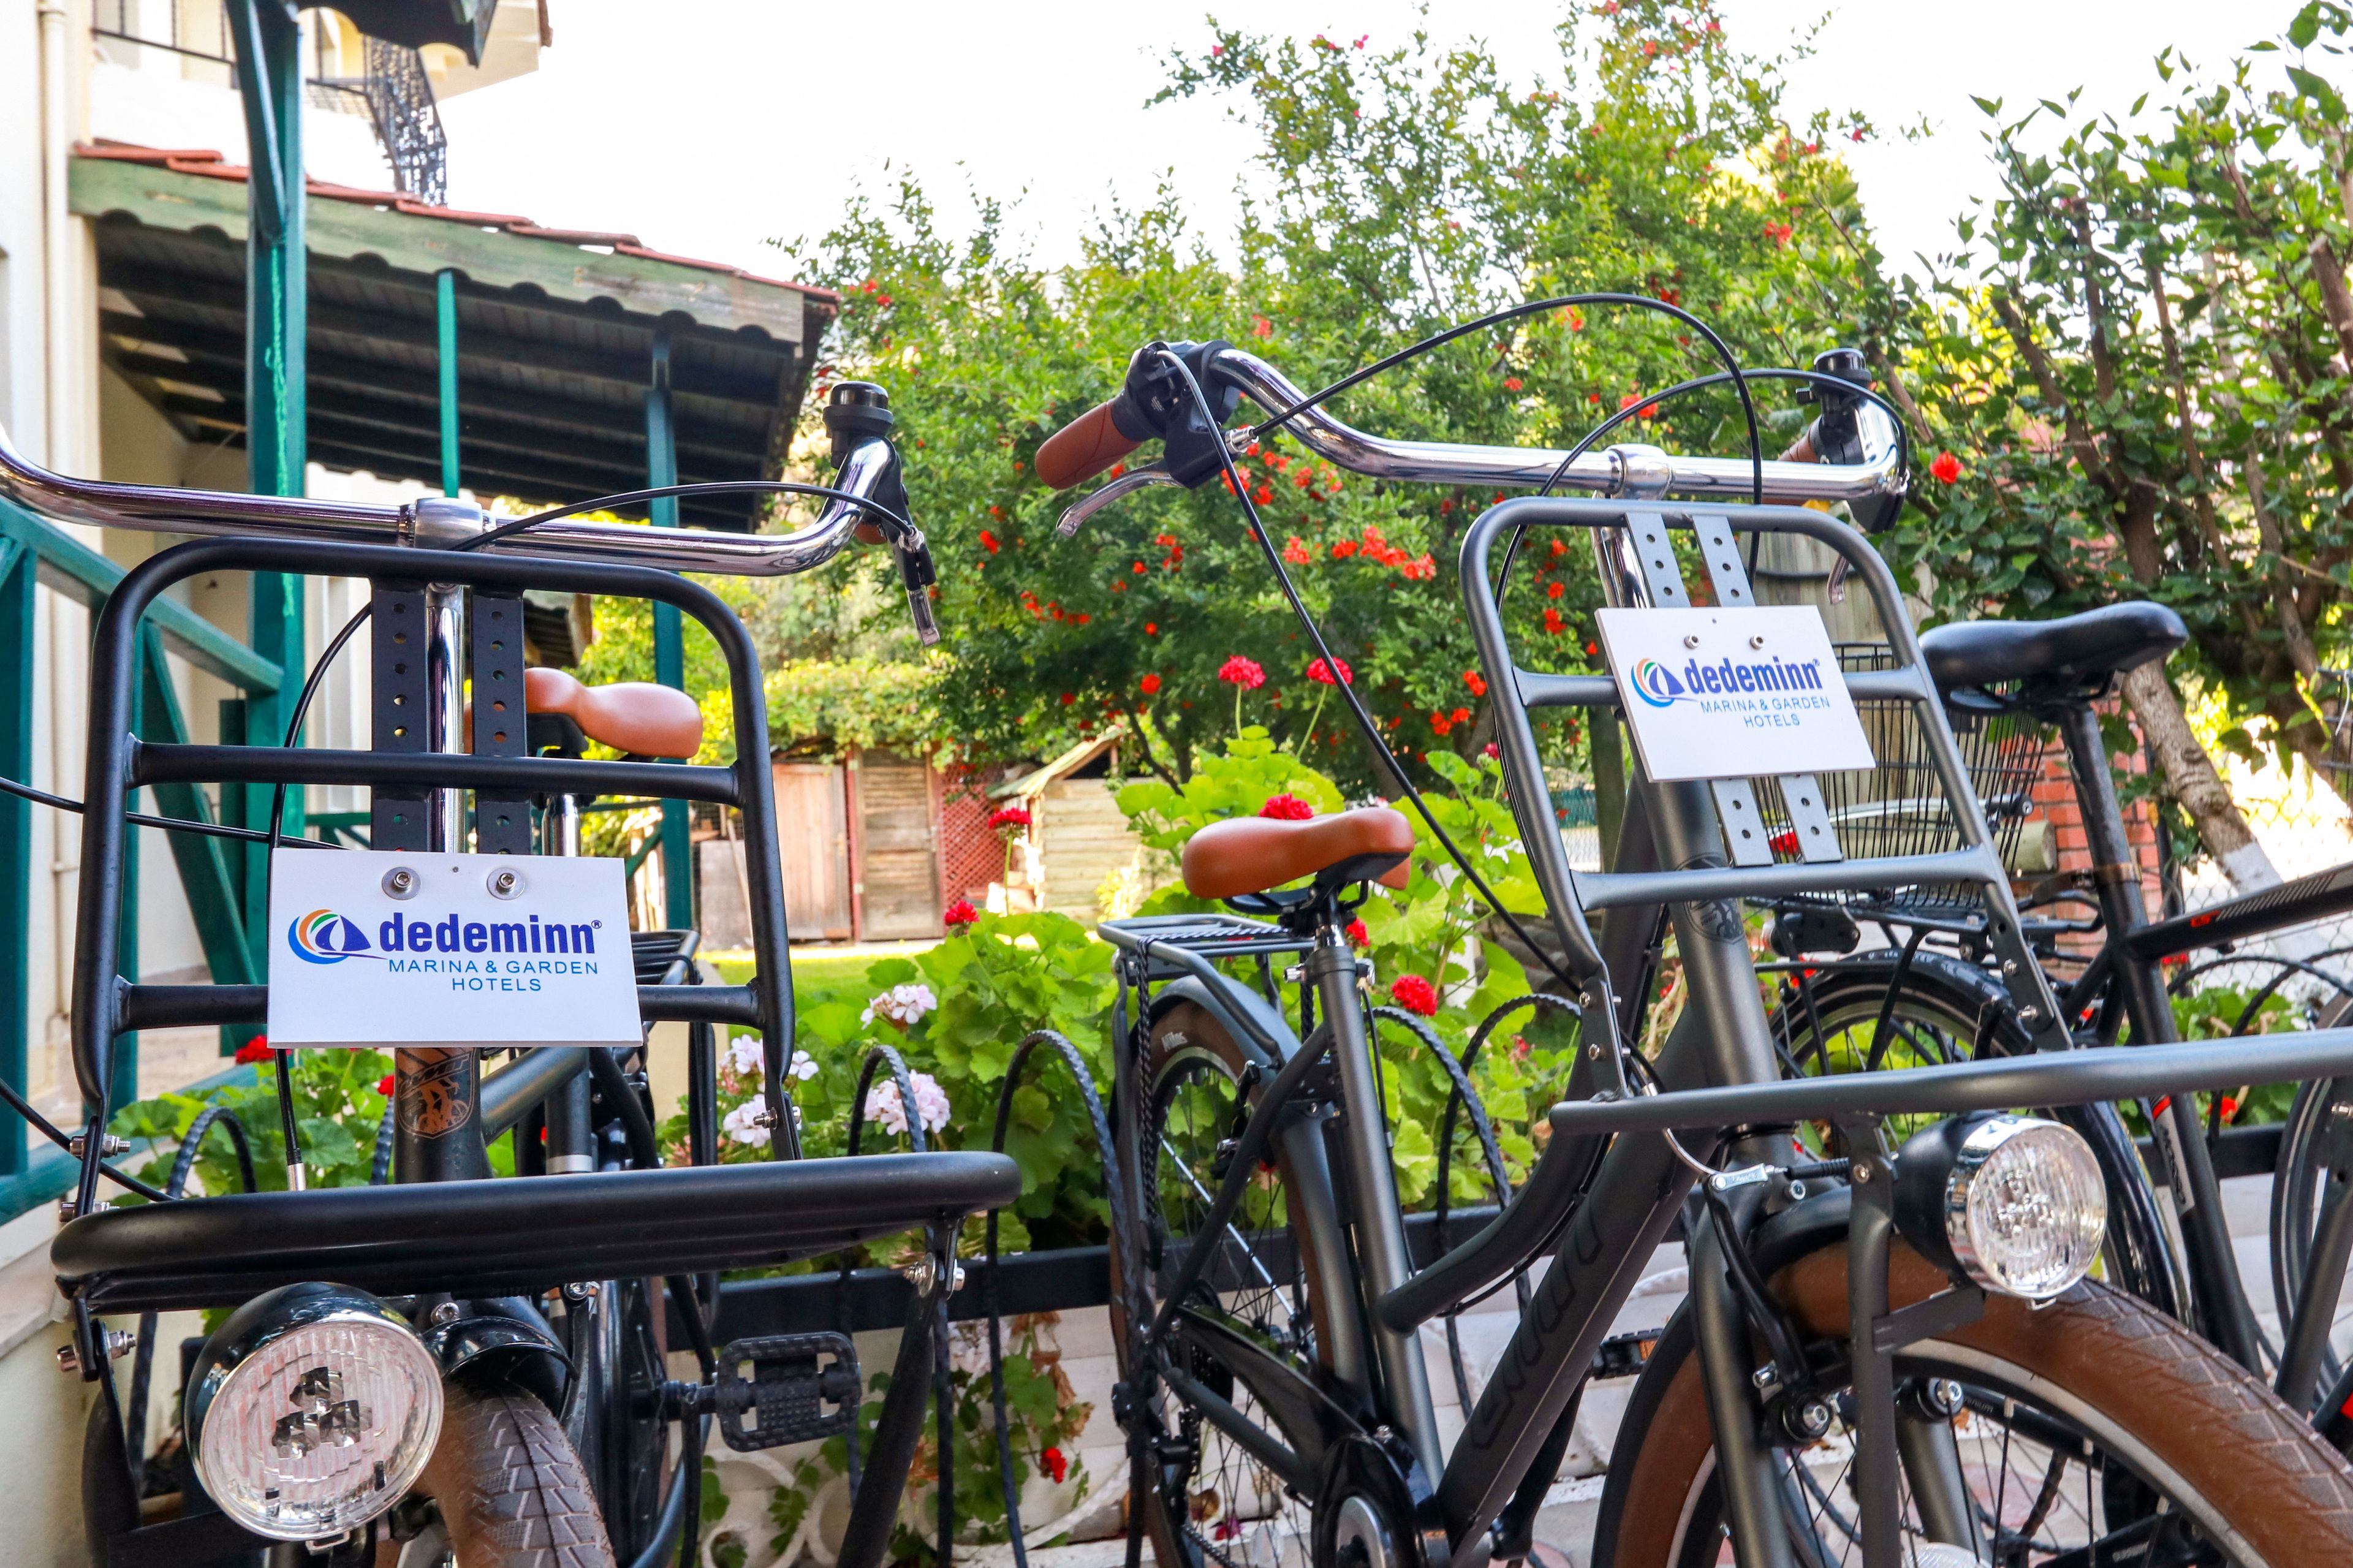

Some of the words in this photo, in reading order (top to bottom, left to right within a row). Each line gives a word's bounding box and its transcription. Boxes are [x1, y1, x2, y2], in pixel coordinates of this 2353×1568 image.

[1700, 700, 1757, 713] MARINA
[1760, 699, 1769, 711] &
[1772, 696, 1830, 711] GARDEN
[1744, 713, 1800, 728] HOTELS
[388, 959, 477, 974] MARINA
[486, 960, 499, 974] &
[506, 960, 598, 975] GARDEN
[452, 977, 542, 992] HOTELS
